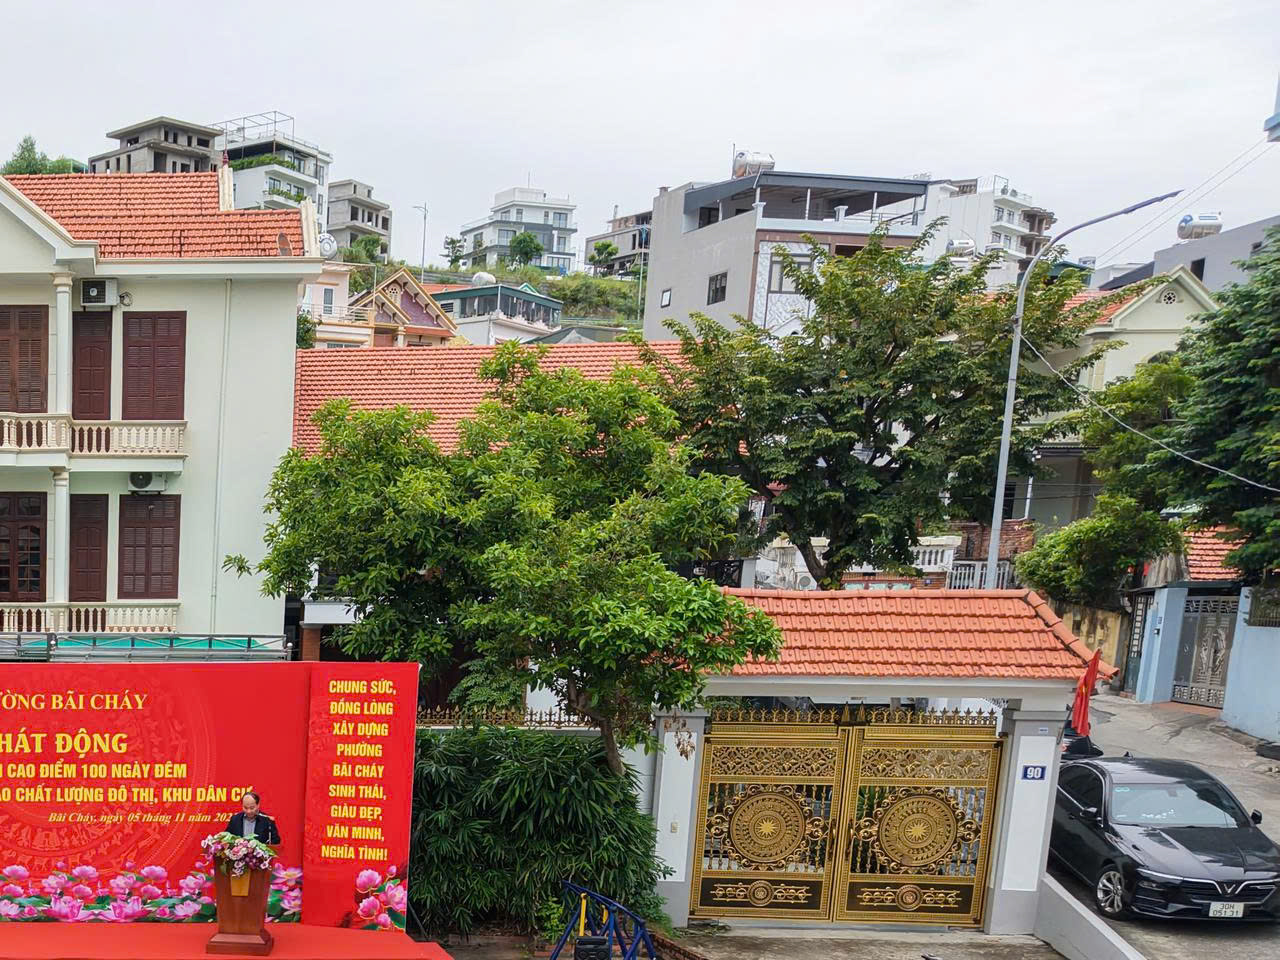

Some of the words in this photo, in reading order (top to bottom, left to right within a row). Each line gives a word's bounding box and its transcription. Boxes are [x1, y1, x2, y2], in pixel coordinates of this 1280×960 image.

[329, 680, 367, 694] CHUNG
[370, 678, 397, 695] SỨC,
[51, 690, 85, 710] BÃI
[89, 690, 148, 710] CHÁY
[363, 699, 394, 715] LÒNG
[333, 720, 354, 736] XÂY
[357, 722, 389, 738] DỰNG
[54, 727, 128, 759] ĐỘNG
[336, 741, 383, 757] PHƯỜNG
[7, 763, 36, 778] CAO
[40, 758, 77, 778] ĐIỂM
[81, 763, 107, 779] 100
[111, 760, 150, 779] NGÀY
[154, 760, 187, 779] ĐÊM
[333, 761, 352, 777] BÃI
[354, 762, 385, 778] CHÁY
[1026, 767, 1042, 779] 90
[15, 782, 52, 802] CHẤT
[56, 786, 104, 805] LƯỢNG
[108, 785, 128, 802] ĐÔ
[132, 788, 158, 805] THỊ,
[162, 787, 192, 802] KHU
[196, 784, 227, 802] DÂN
[328, 784, 356, 798] SINH
[358, 784, 387, 800] THÁI,
[48, 812, 66, 823] Bãi
[68, 812, 97, 825] Cháy,
[99, 812, 123, 824] ngày
[127, 812, 141, 823] 05
[141, 812, 172, 824] tháng
[175, 813, 186, 823] 11
[188, 813, 211, 823] năm
[213, 812, 238, 823] 202
[330, 802, 357, 818] GIÀU
[326, 823, 349, 838] VĂN
[351, 826, 385, 842] MINH,
[321, 844, 356, 859] NGHĨA
[358, 845, 388, 861] TÌNH!
